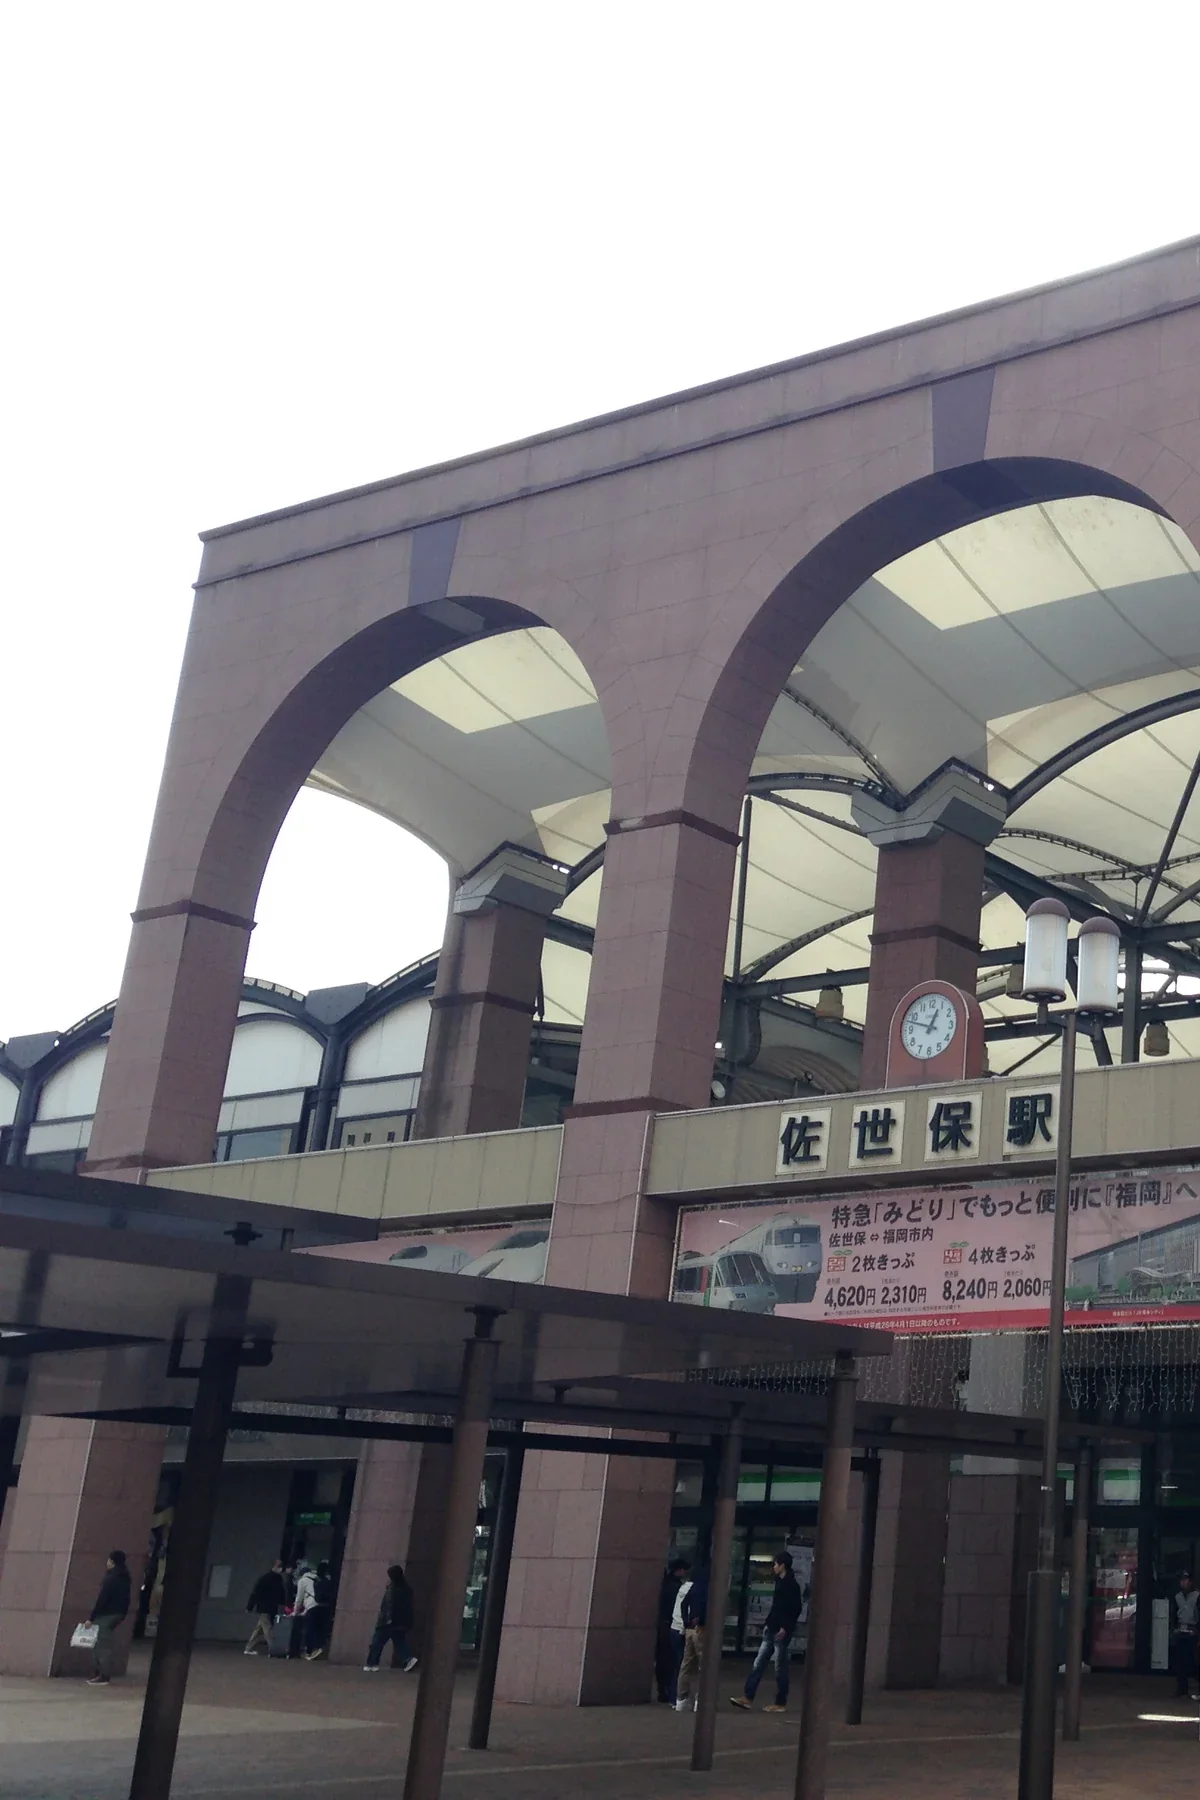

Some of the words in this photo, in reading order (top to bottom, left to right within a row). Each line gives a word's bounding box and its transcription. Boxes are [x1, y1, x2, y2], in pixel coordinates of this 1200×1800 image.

[780, 1093, 1052, 1165] 佐世保駅
[829, 1231, 866, 1248] 佐世保
[883, 1226, 934, 1244] 福岡市内
[851, 1252, 915, 1273] 2枚きっぷ
[968, 1244, 1036, 1266] 4枚きっぷ
[824, 1285, 876, 1310] 4,620円
[881, 1285, 927, 1308] 2,310円
[942, 1278, 998, 1303] 8,240円
[1003, 1277, 1052, 1301] 2,060円
